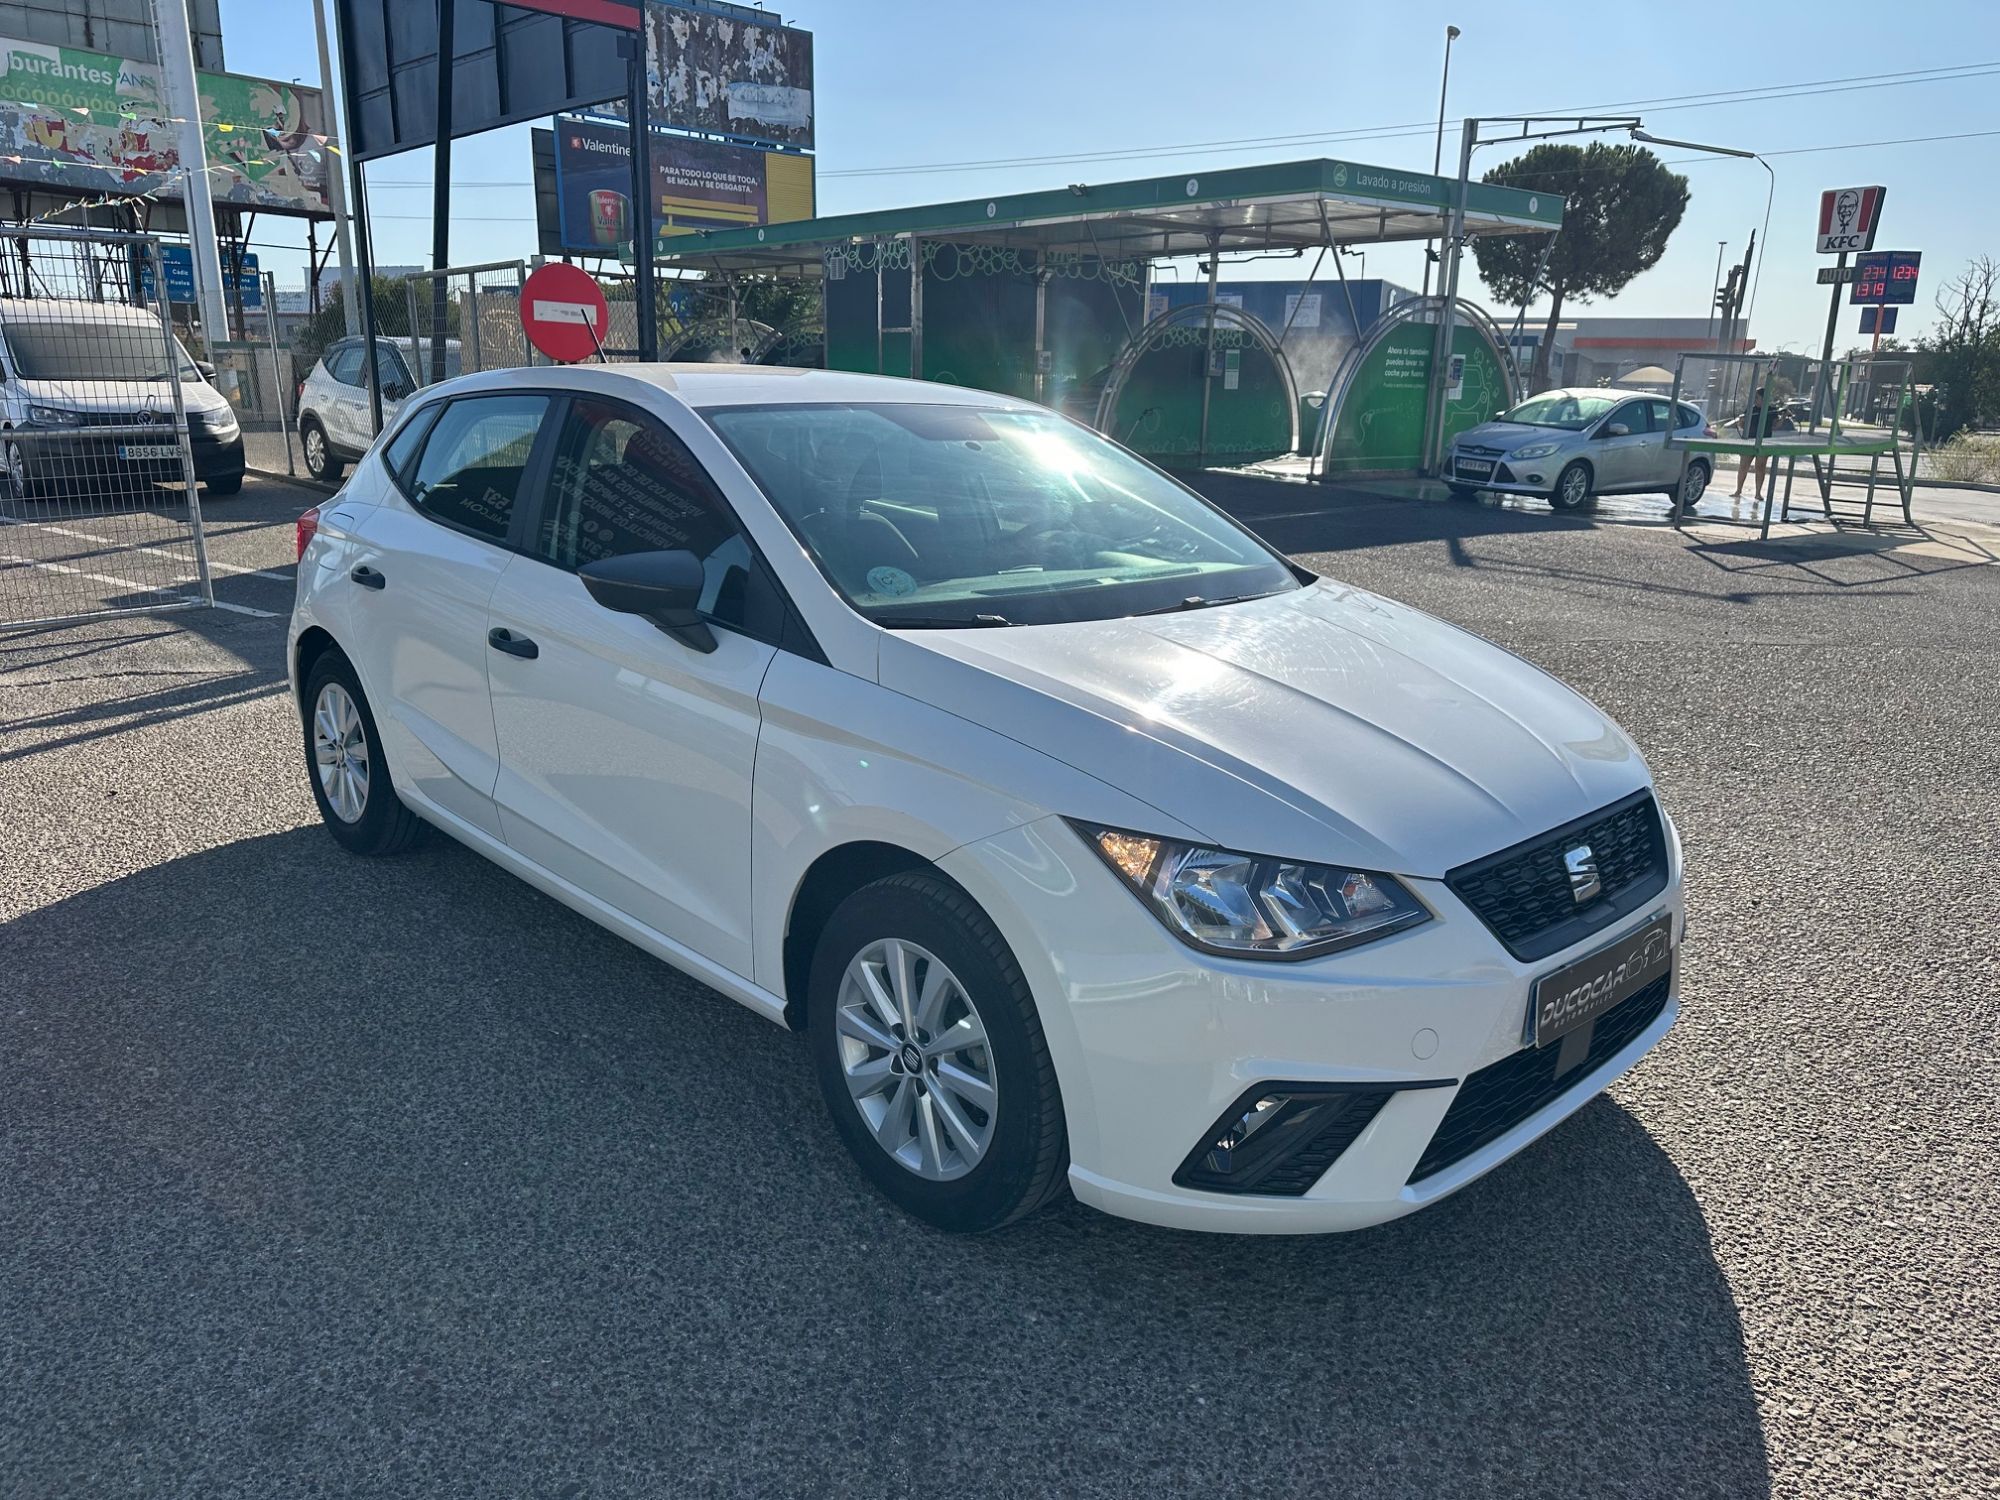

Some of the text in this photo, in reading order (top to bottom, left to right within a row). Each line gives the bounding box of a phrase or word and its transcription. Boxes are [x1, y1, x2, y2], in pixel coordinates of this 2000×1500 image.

[9, 50, 113, 85] burantes
[659, 165, 758, 187] PARA TODO LO QUE SE TOCA,
[666, 176, 676, 184] SE
[677, 178, 699, 187] MOJA
[699, 180, 705, 188] Y
[705, 181, 715, 189] SE
[1356, 171, 1431, 195] Lavado a presión
[1824, 235, 1861, 250] KFC
[1820, 268, 1851, 283] AUTO
[1540, 963, 1627, 1028] DUCOCAR
